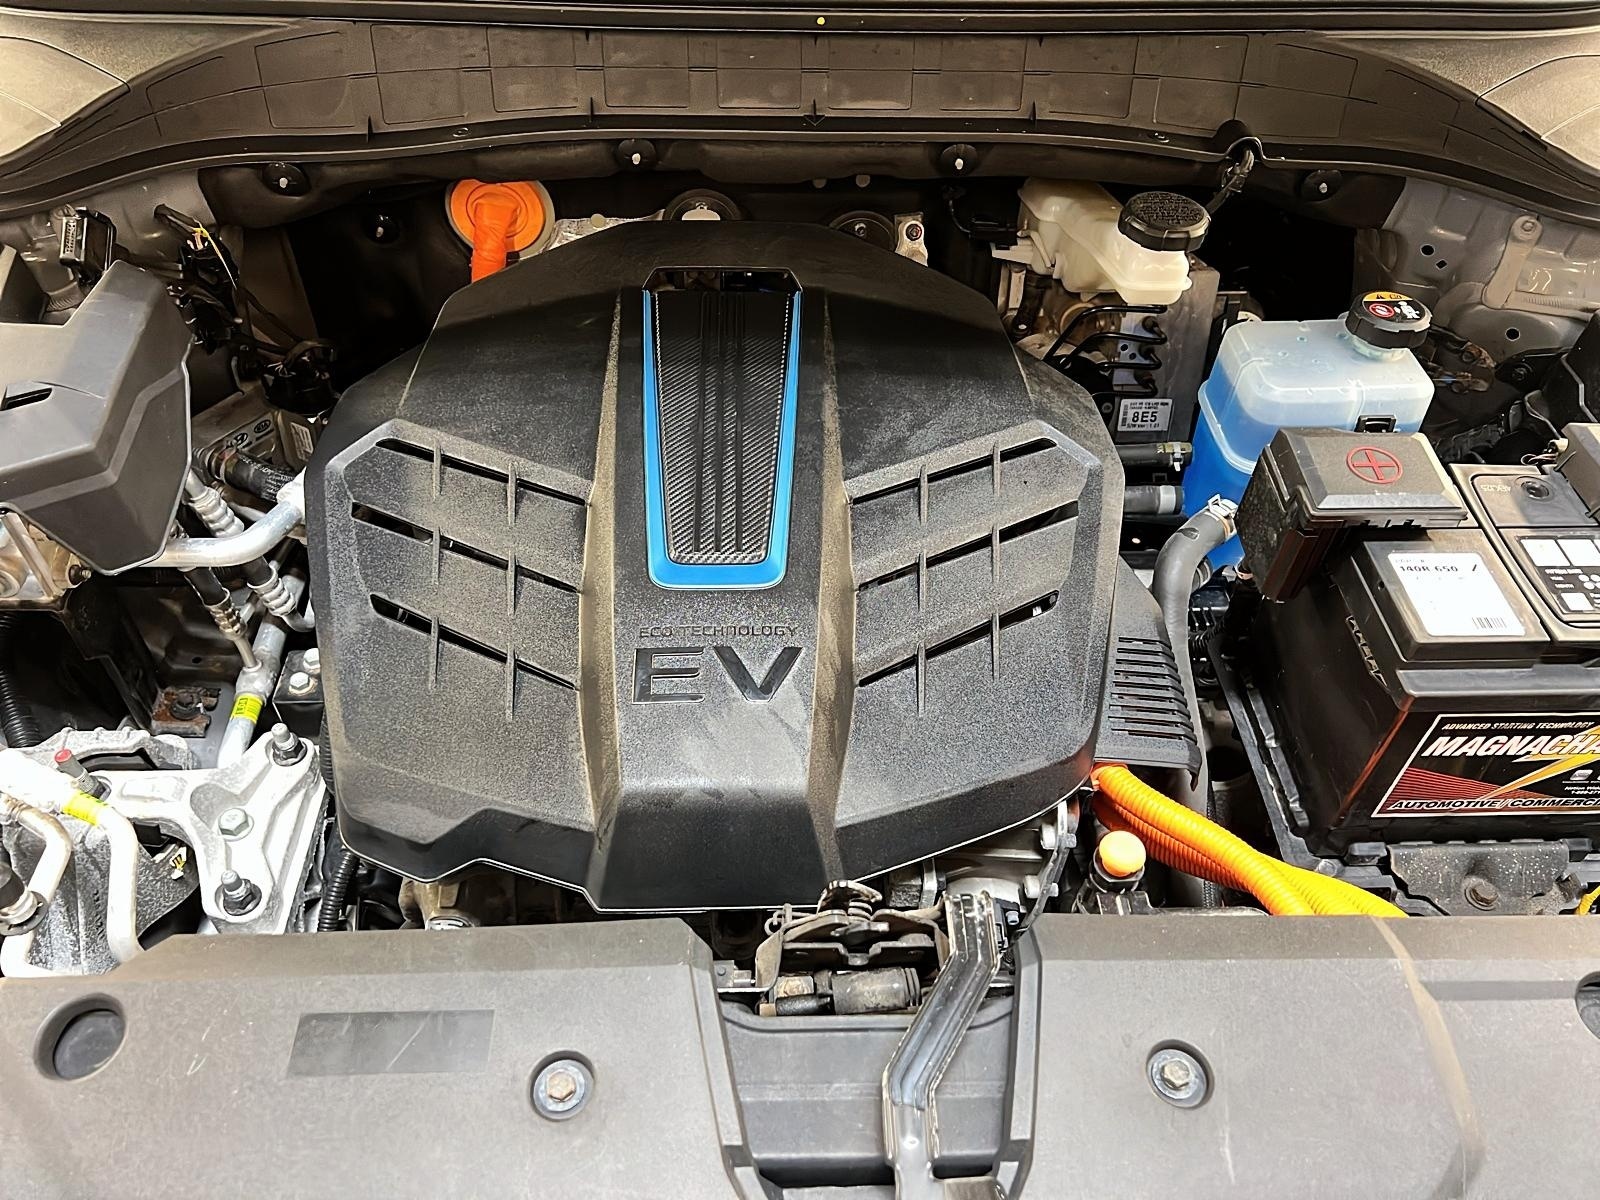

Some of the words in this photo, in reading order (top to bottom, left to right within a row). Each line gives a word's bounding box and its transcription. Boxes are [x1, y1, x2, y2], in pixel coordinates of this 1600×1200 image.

[1131, 411, 1158, 423] 8E5
[639, 626, 673, 639] ECO
[678, 624, 798, 638] TECHNOLOGY
[632, 646, 803, 704] EV
[1491, 722, 1536, 730] STARTING
[1535, 721, 1595, 729] TECHNOLOGY
